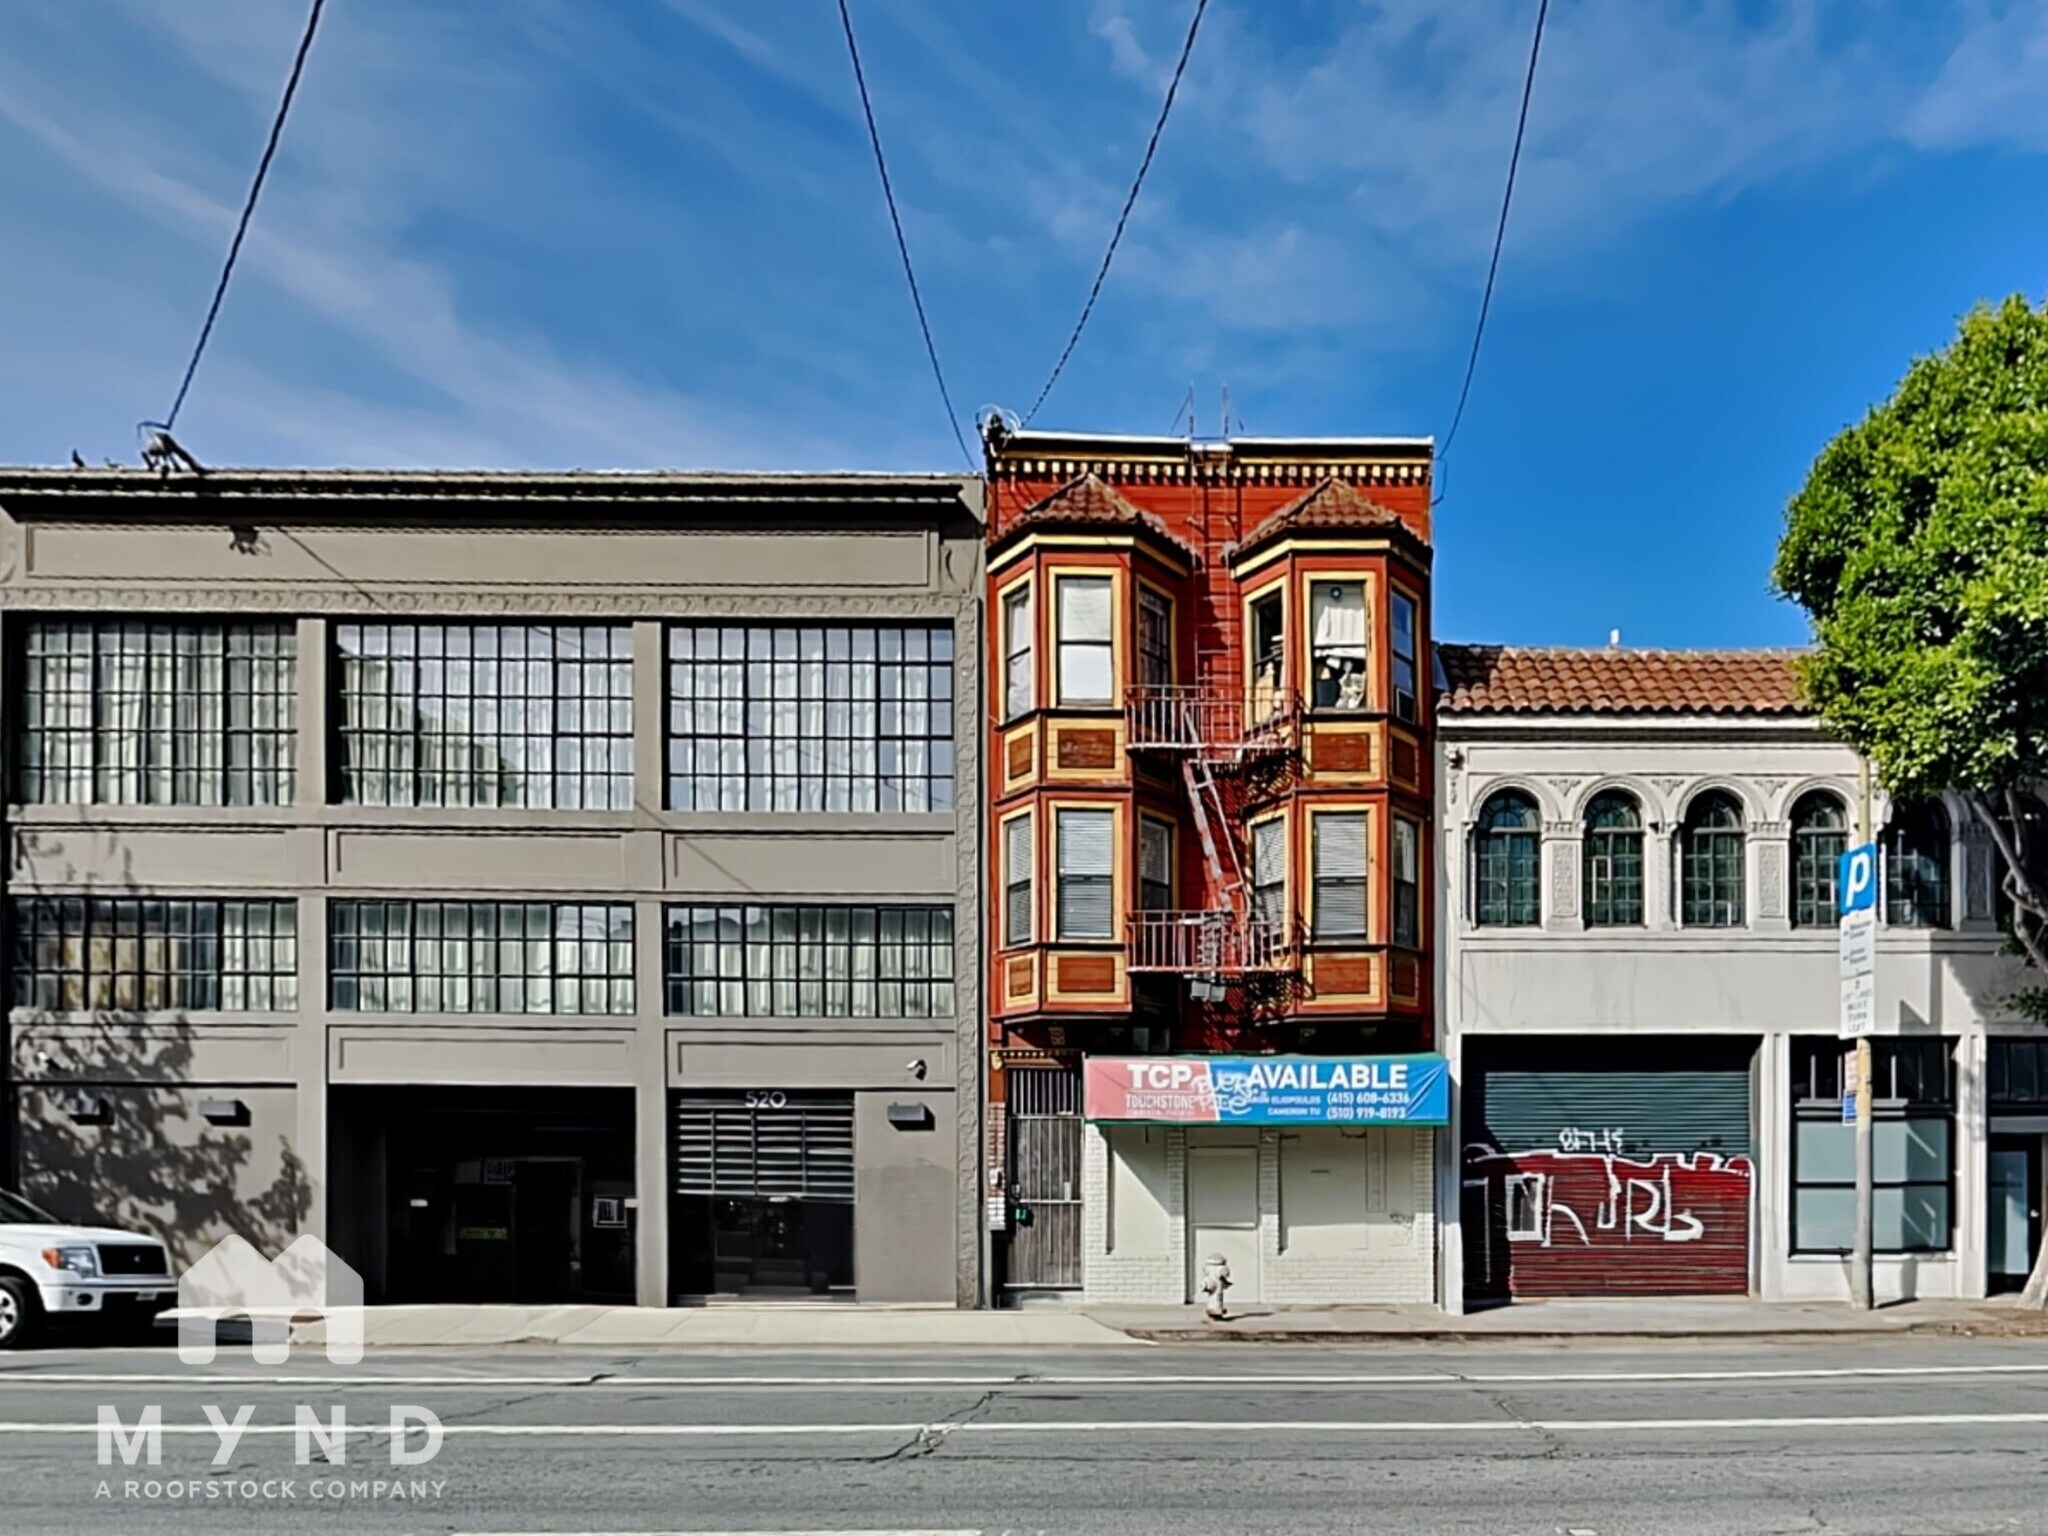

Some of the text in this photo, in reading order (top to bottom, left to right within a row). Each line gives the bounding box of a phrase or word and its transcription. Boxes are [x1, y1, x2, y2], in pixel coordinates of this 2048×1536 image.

[1126, 1064, 1193, 1090] TCP
[1248, 1064, 1408, 1089] AVAILABLE
[745, 1091, 787, 1108] 520
[1126, 1094, 1194, 1109] TOUCHSTONE
[1327, 1092, 1354, 1106] (415)
[1326, 1107, 1354, 1120] (510)
